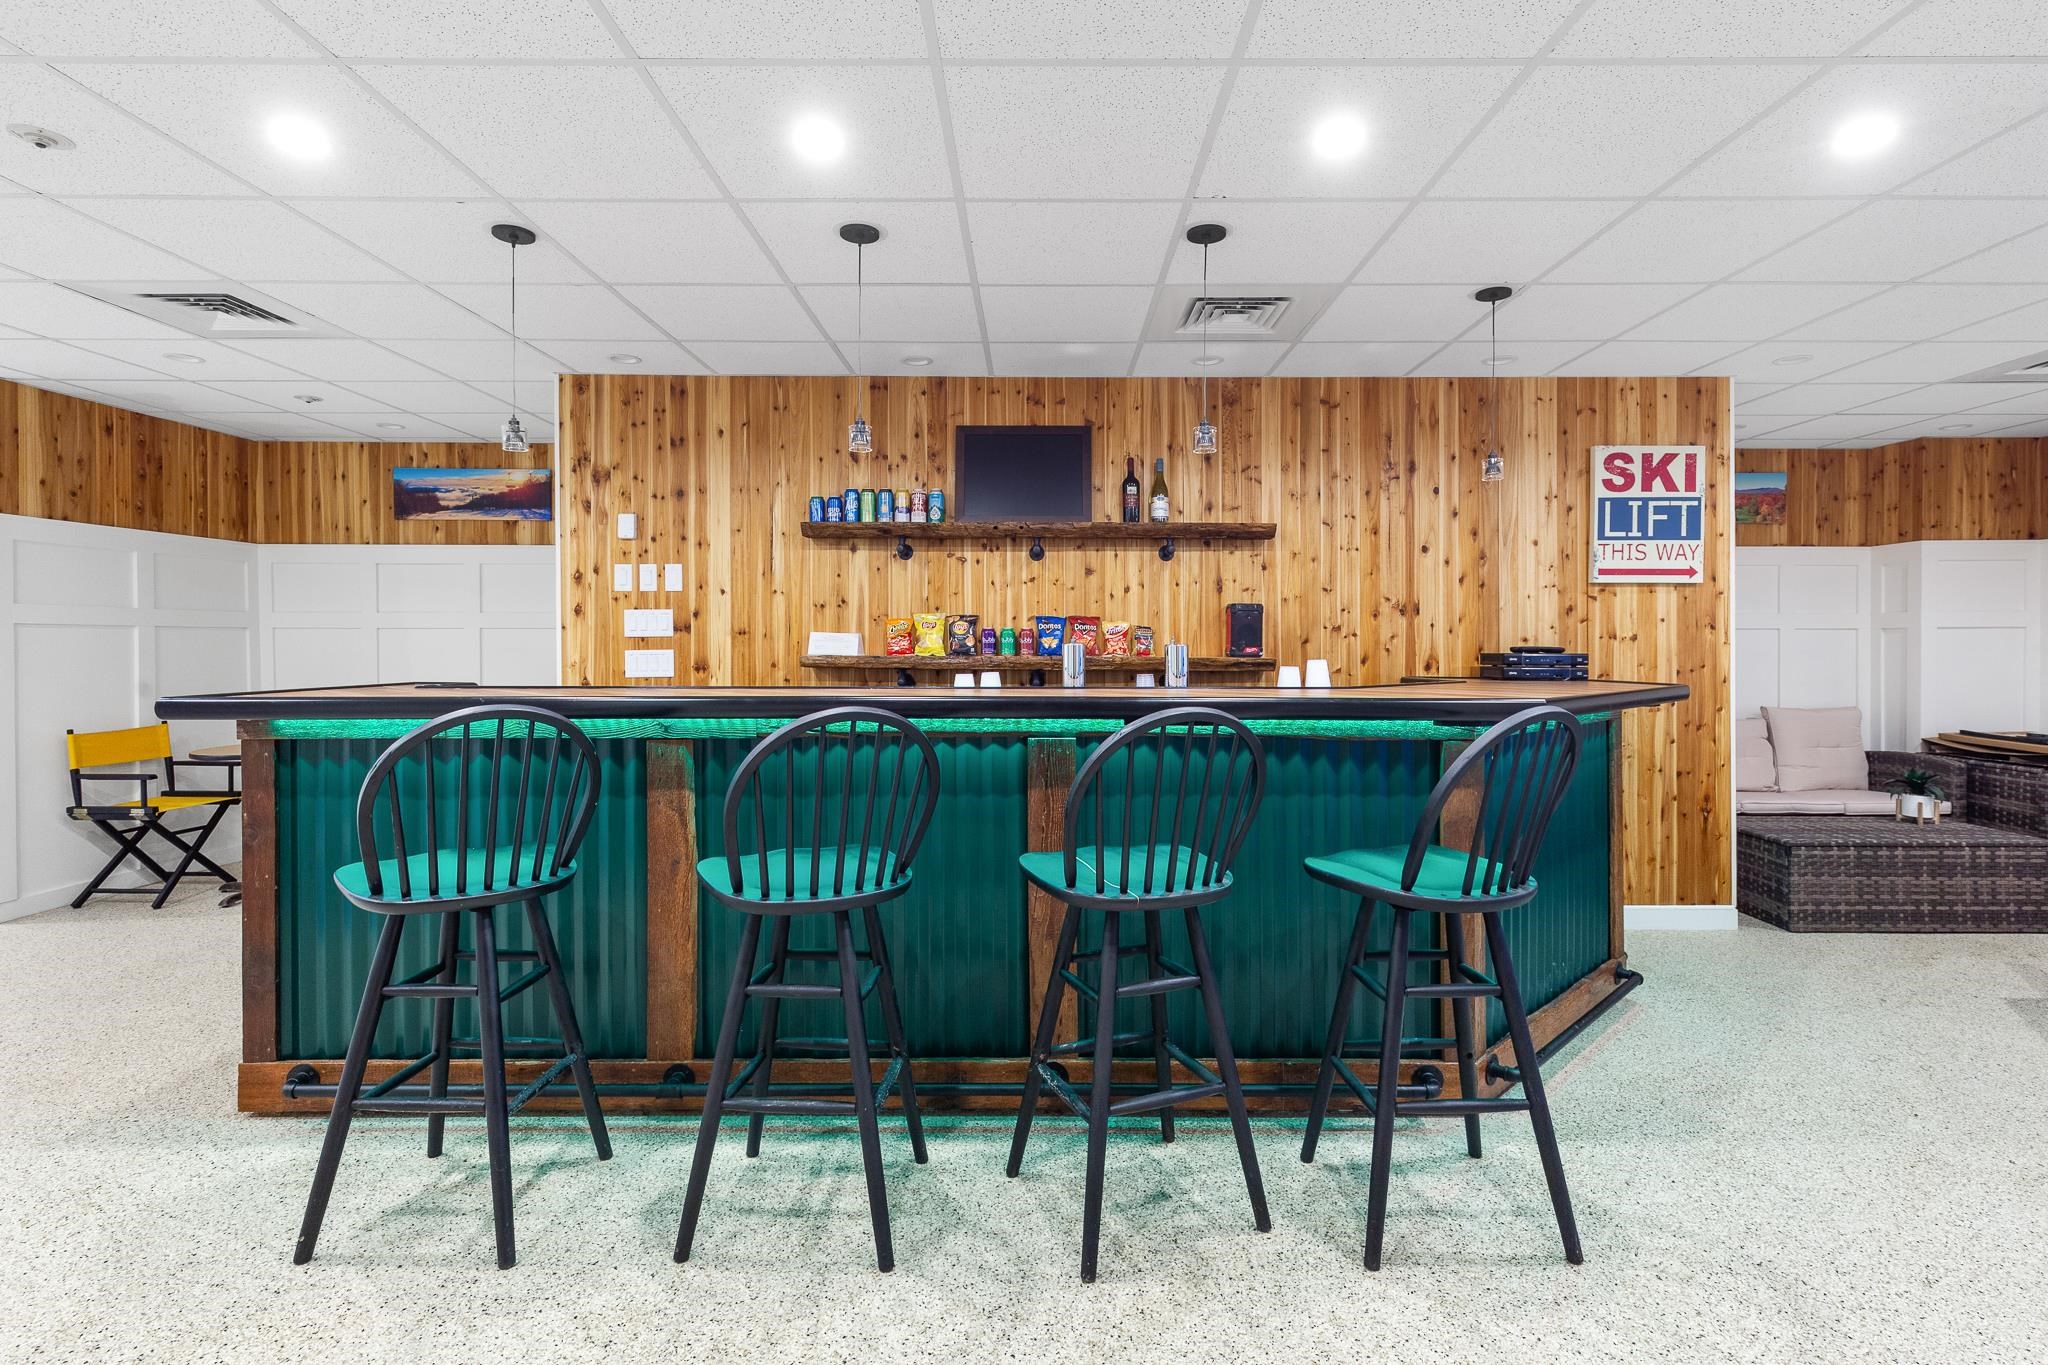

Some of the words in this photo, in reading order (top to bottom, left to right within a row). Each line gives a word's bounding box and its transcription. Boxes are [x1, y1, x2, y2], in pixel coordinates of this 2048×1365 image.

[1601, 452, 1697, 493] SKI
[1604, 500, 1699, 537] LIFT
[1598, 543, 1647, 561] THIS
[1655, 543, 1700, 561] WAY
[1074, 623, 1097, 631] Doritos
